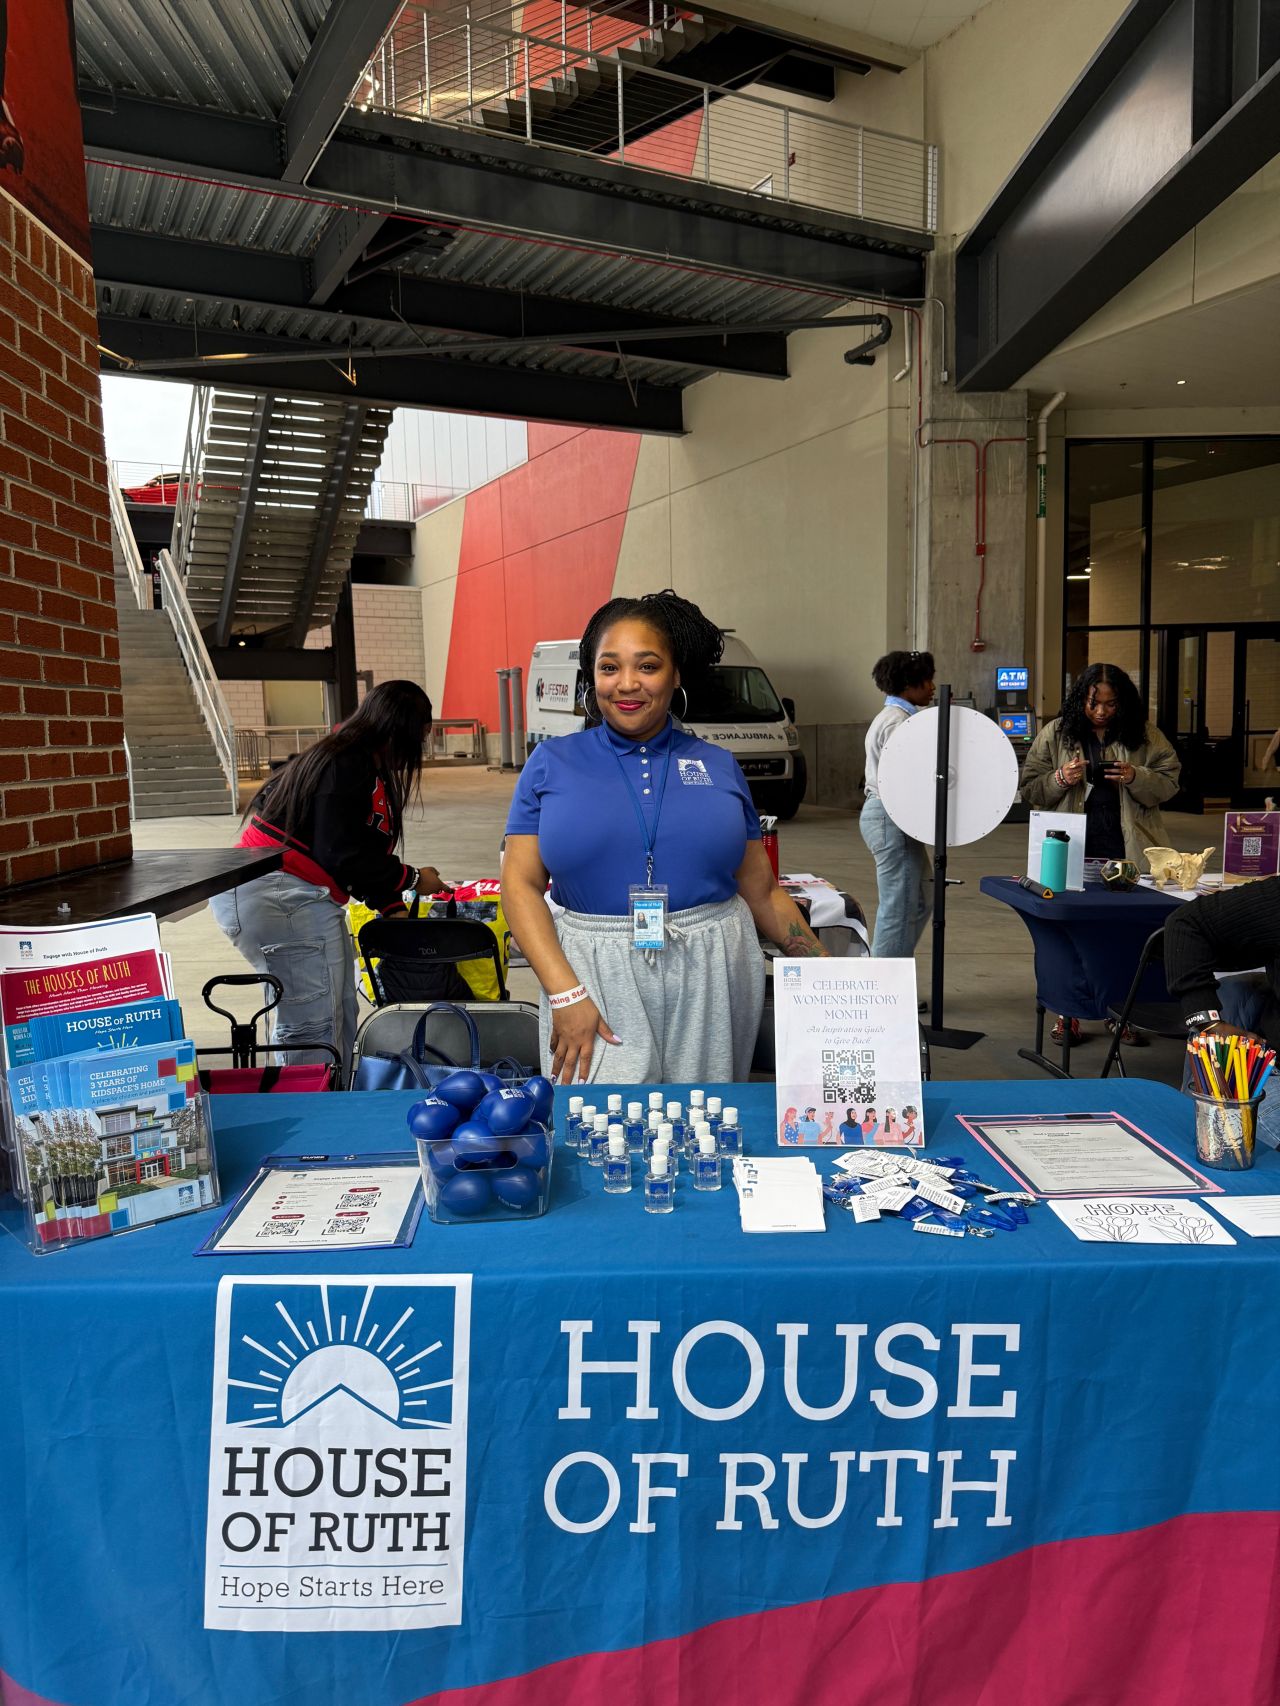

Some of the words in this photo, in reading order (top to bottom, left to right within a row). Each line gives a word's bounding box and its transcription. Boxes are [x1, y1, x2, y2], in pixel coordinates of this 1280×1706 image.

[1000, 672, 1026, 681] ATM
[24, 979, 42, 996] THE
[42, 970, 84, 992] HOUSES
[102, 960, 131, 981] RUTH
[813, 980, 879, 990] CELEBRATE
[793, 994, 847, 1005] WOMEN'S
[850, 994, 899, 1005] HISTORY
[66, 1016, 112, 1032] HOUSE
[125, 1008, 162, 1024] RUTH
[825, 1009, 868, 1020] MONTH
[821, 1026, 862, 1035] Inspiration
[864, 1025, 886, 1033] Guide
[833, 1037, 850, 1045] Give
[90, 1064, 149, 1080] CELEBRATING
[91, 1084, 139, 1098] KIDSPACE'S
[140, 1079, 166, 1090] HOME
[97, 1077, 126, 1088] YEARS
[126, 1075, 138, 1084] OF
[1084, 1203, 1184, 1216] HOPE
[558, 1320, 1021, 1421] HOUSE
[222, 1446, 451, 1498] HOUSE
[543, 1451, 689, 1534] OF
[716, 1450, 1017, 1530] RUTH
[221, 1511, 296, 1553] OF
[308, 1511, 451, 1553] RUTH
[220, 1575, 290, 1603] Hope
[299, 1576, 373, 1598] Starts
[381, 1575, 444, 1597] Here
